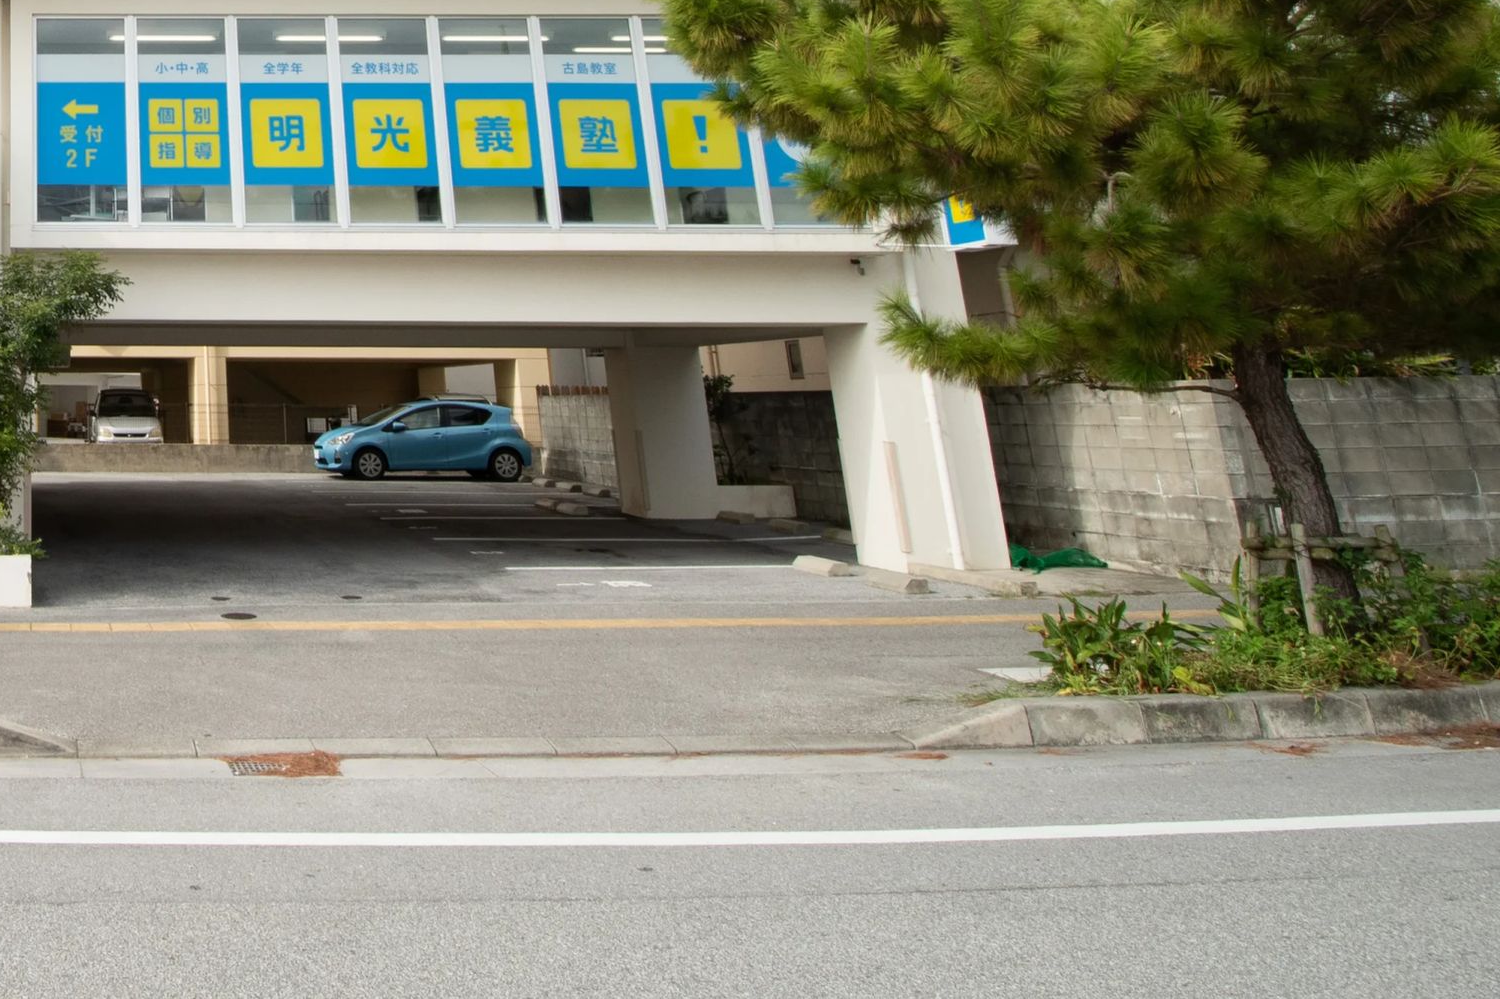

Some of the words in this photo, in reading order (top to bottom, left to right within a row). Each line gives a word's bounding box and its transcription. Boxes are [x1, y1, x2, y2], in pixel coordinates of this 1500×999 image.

[263, 62, 304, 75] 全学年
[351, 62, 419, 75] 全教科対応
[562, 62, 617, 75] 古島教室
[60, 125, 104, 143] 受付
[66, 149, 98, 168] 2F
